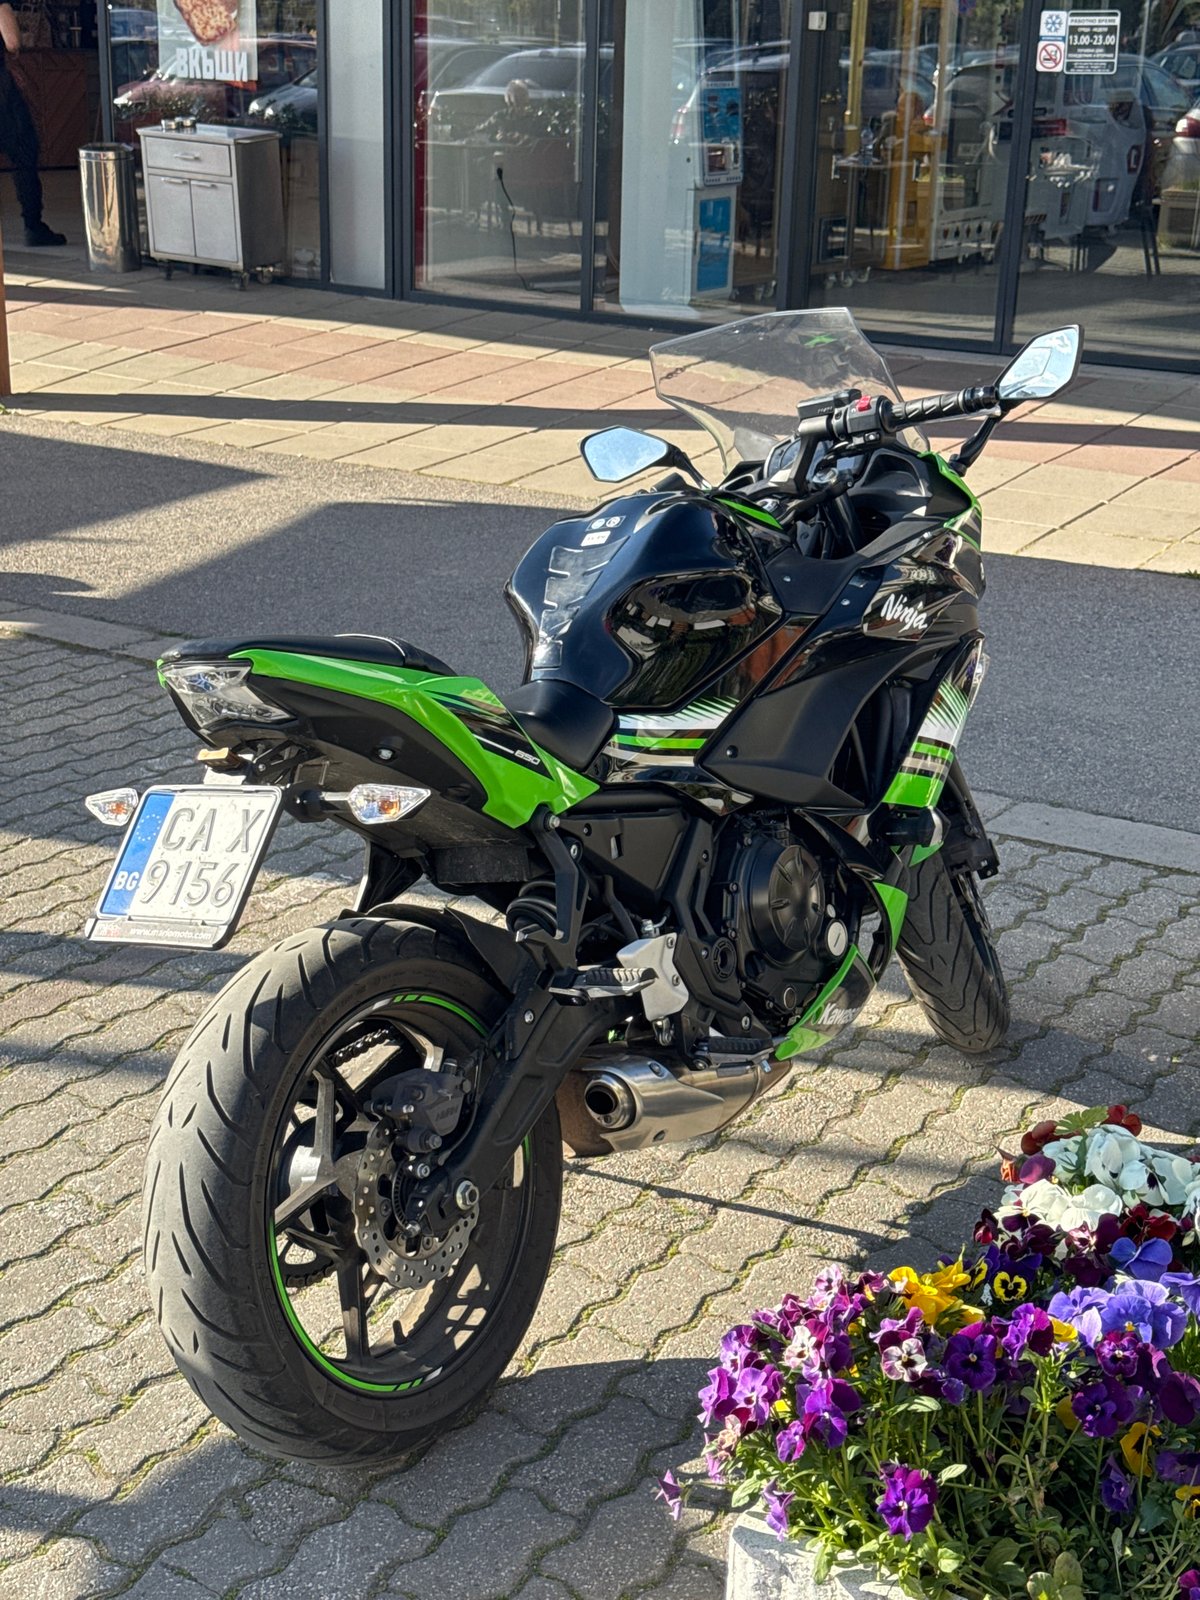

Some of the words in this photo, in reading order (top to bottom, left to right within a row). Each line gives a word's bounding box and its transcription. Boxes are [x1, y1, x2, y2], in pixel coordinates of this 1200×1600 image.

[1069, 34, 1116, 46] 13.00-23.00
[880, 593, 928, 633] Ninja
[514, 749, 541, 766] 650
[162, 807, 217, 852] CA
[226, 808, 265, 853] X
[113, 871, 140, 890] BG
[140, 859, 240, 908] 9156
